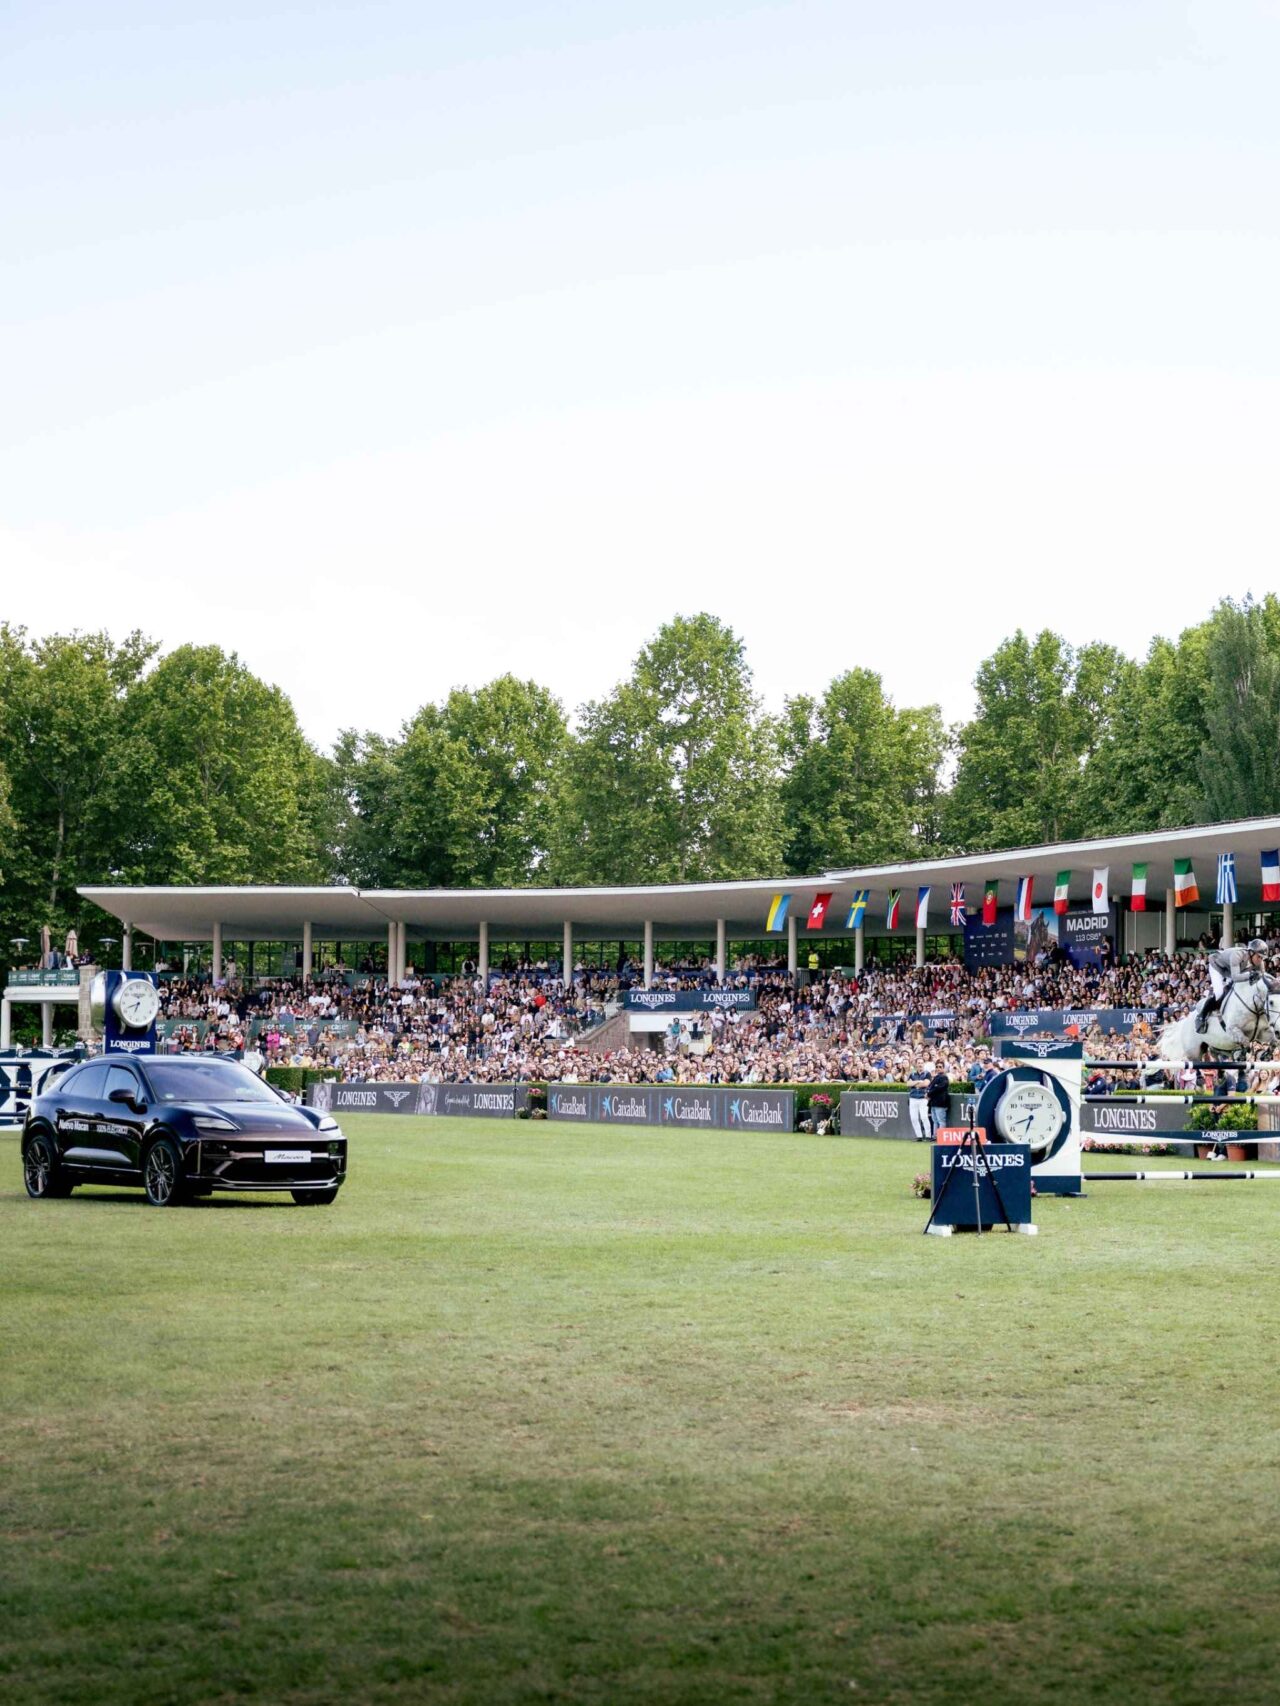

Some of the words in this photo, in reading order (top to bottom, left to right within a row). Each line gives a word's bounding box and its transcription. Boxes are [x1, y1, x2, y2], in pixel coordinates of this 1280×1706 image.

[1067, 916, 1109, 931] MADRID
[631, 993, 676, 1003] LONGINES
[703, 993, 750, 1003] LONGINES
[1005, 1015, 1039, 1026] LONGINES
[110, 1039, 150, 1049] LONGINES
[337, 1091, 377, 1106] LONGINES
[473, 1093, 514, 1111] LONGINES
[557, 1094, 587, 1116] CaixaBank
[612, 1095, 647, 1118] CaixaBank
[674, 1097, 711, 1121] CaixaBank
[741, 1099, 783, 1124] CaixaBank
[855, 1100, 899, 1119] LONGINES
[59, 1119, 74, 1131] Nuevo
[75, 1120, 90, 1132] Macan
[1093, 1107, 1157, 1130] LONGINES
[1201, 1131, 1238, 1139] LONGINES
[941, 1153, 1025, 1168] LONGINES
